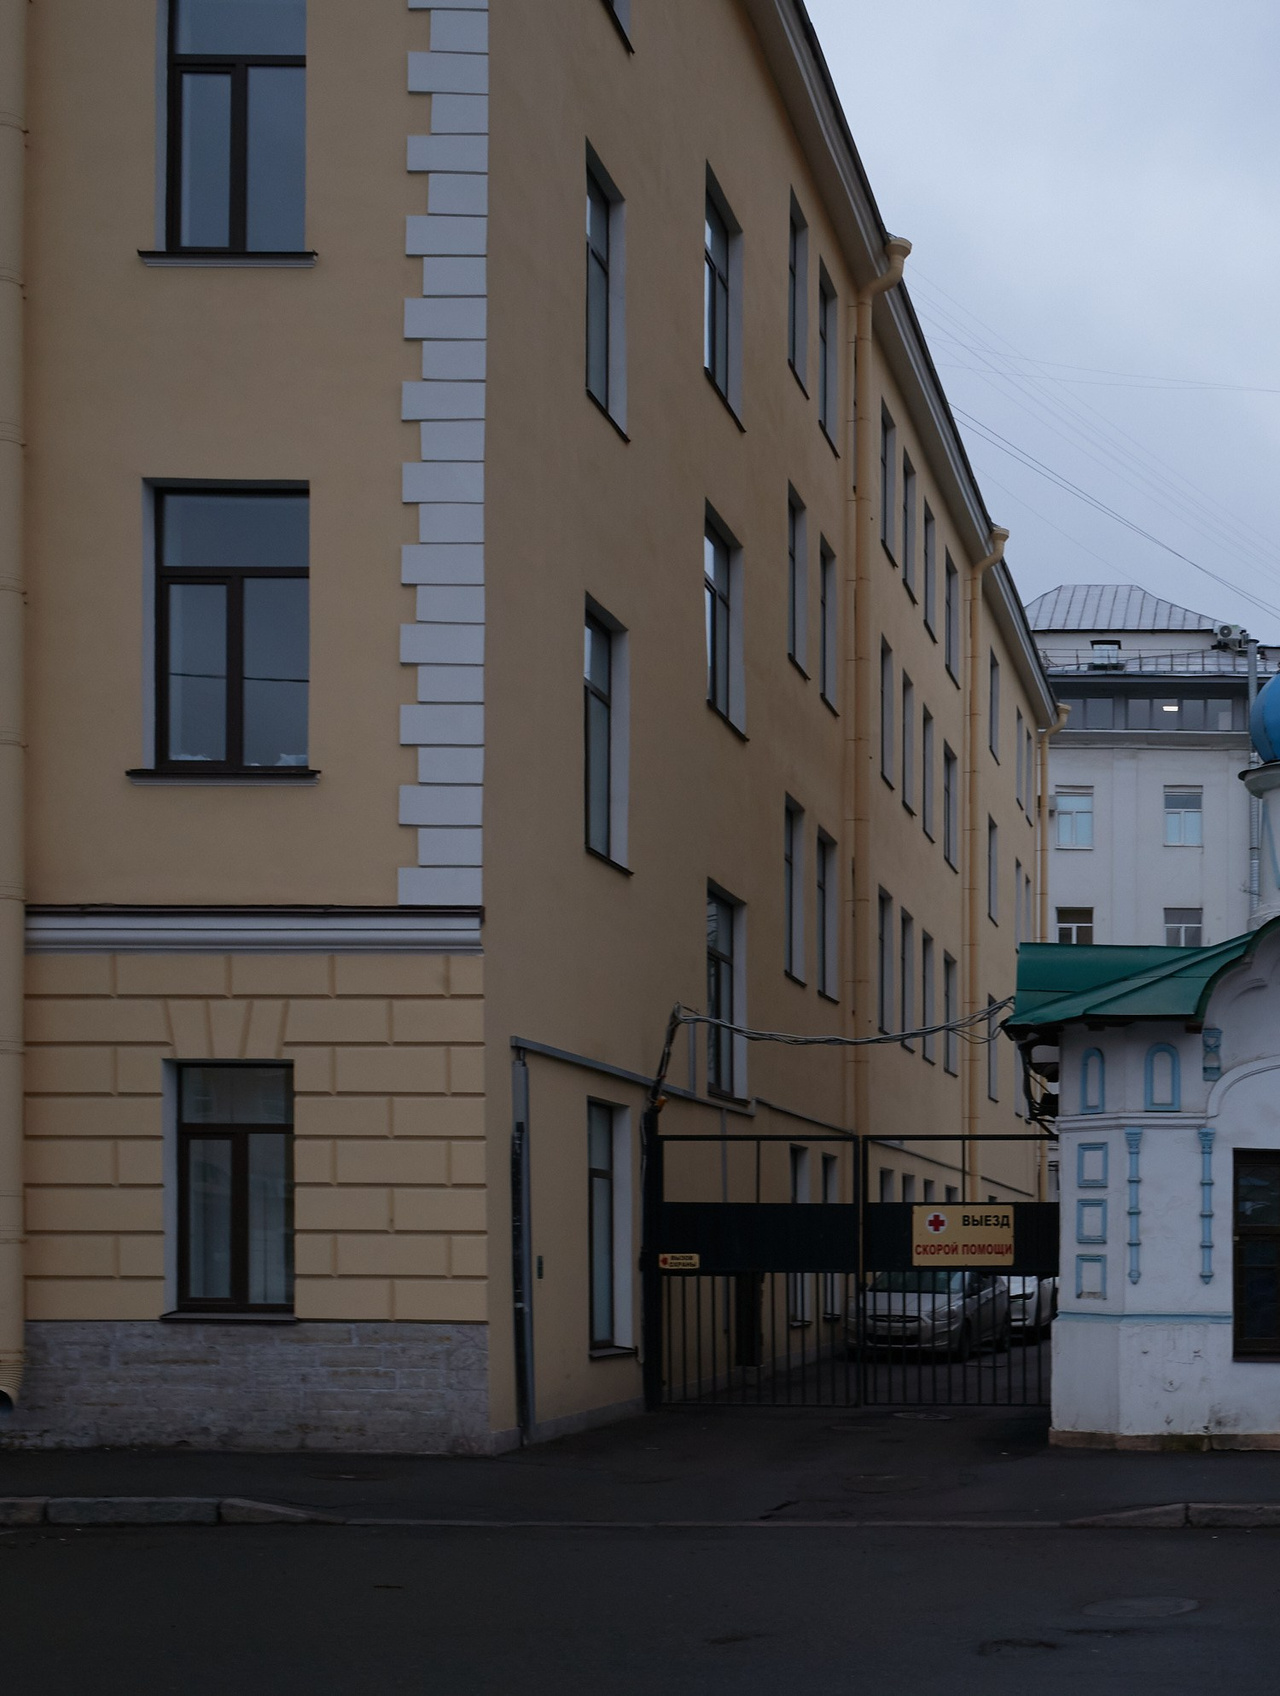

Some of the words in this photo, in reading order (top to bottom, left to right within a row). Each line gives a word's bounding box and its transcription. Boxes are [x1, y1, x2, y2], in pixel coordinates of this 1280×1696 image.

[962, 1215, 1011, 1228] ВЫЕЗД
[915, 1241, 959, 1255] СКОРОЙ
[961, 1243, 1013, 1256] ПОМОЩИ
